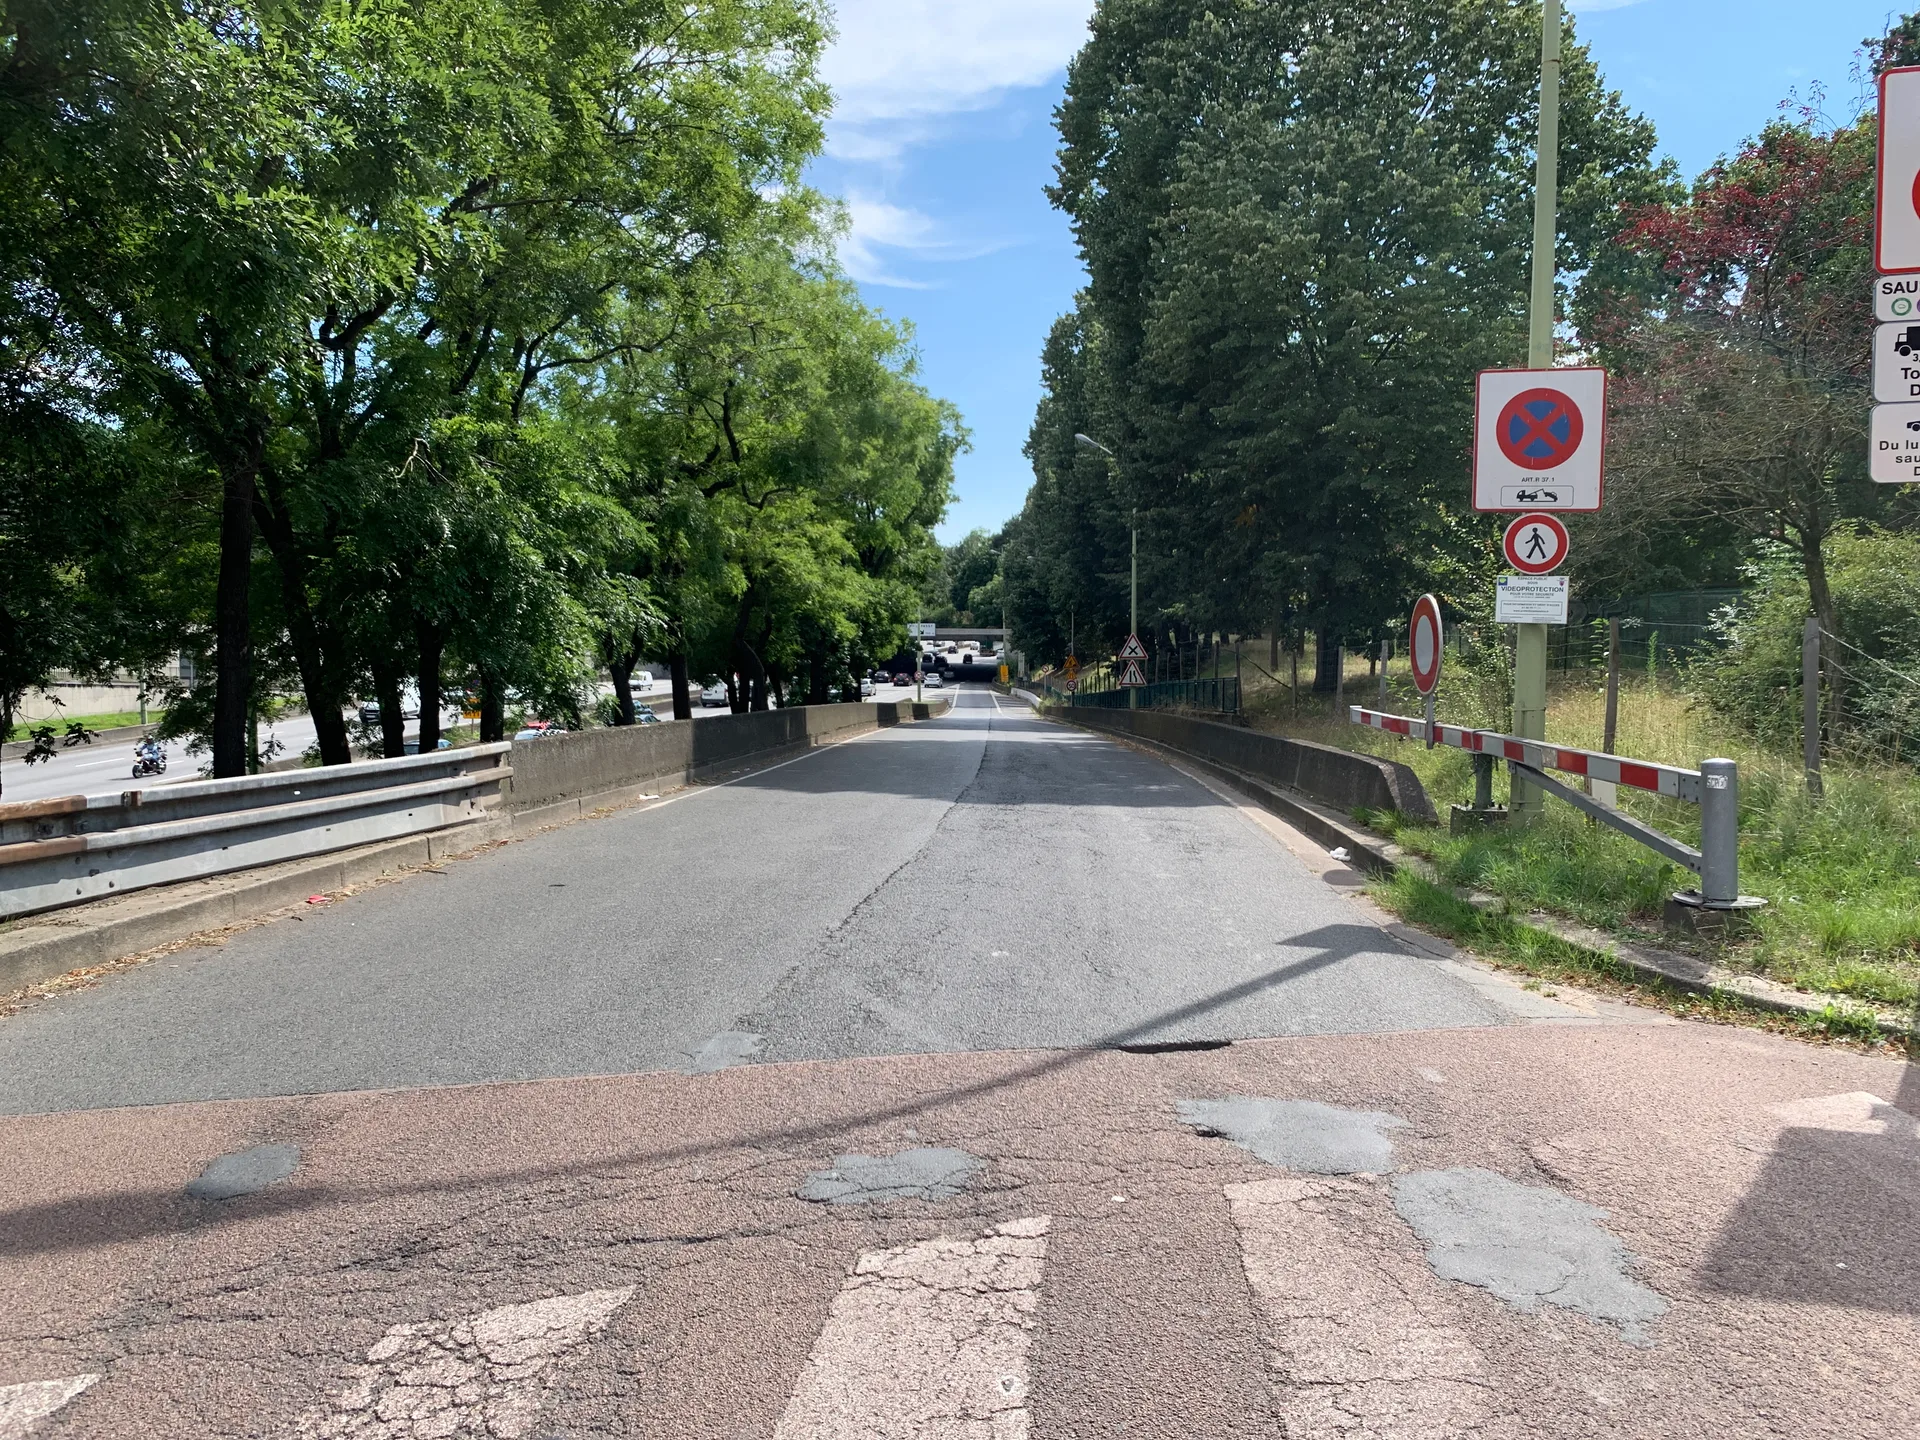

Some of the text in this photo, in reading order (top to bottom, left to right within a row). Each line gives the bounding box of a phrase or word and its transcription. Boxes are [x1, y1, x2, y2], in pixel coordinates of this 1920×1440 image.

[1882, 280, 1920, 295] SAU
[1879, 440, 1899, 451] Du
[1501, 585, 1564, 593] VIDEOPROTECTION
